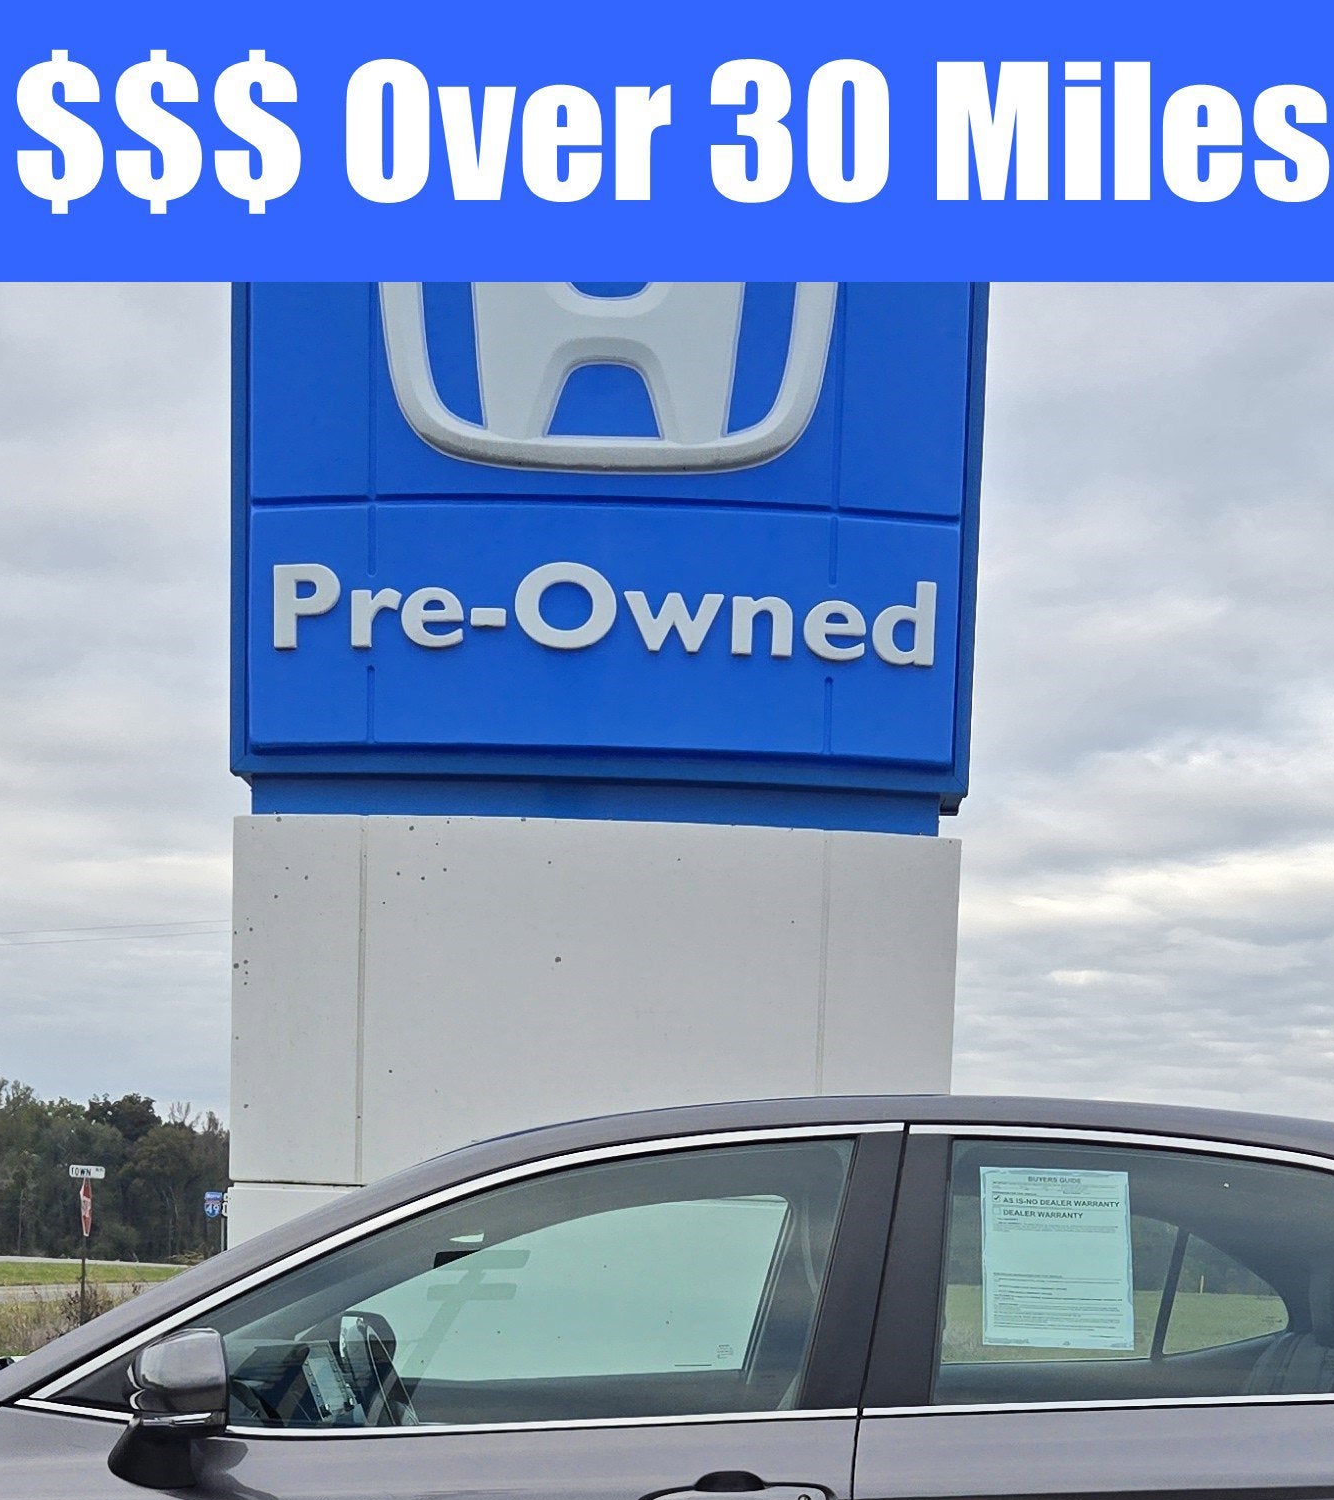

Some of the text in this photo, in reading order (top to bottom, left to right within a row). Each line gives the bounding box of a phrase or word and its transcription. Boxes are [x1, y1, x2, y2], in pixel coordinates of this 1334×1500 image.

[273, 561, 937, 667] Pre-Owned
[1027, 1175, 1058, 1183] BUYERS
[1040, 1199, 1072, 1207] DEALER
[1074, 1200, 1120, 1208] WARRANTY
[205, 1203, 220, 1216] 49
[1003, 1209, 1084, 1219] DEALER WARRANTY
